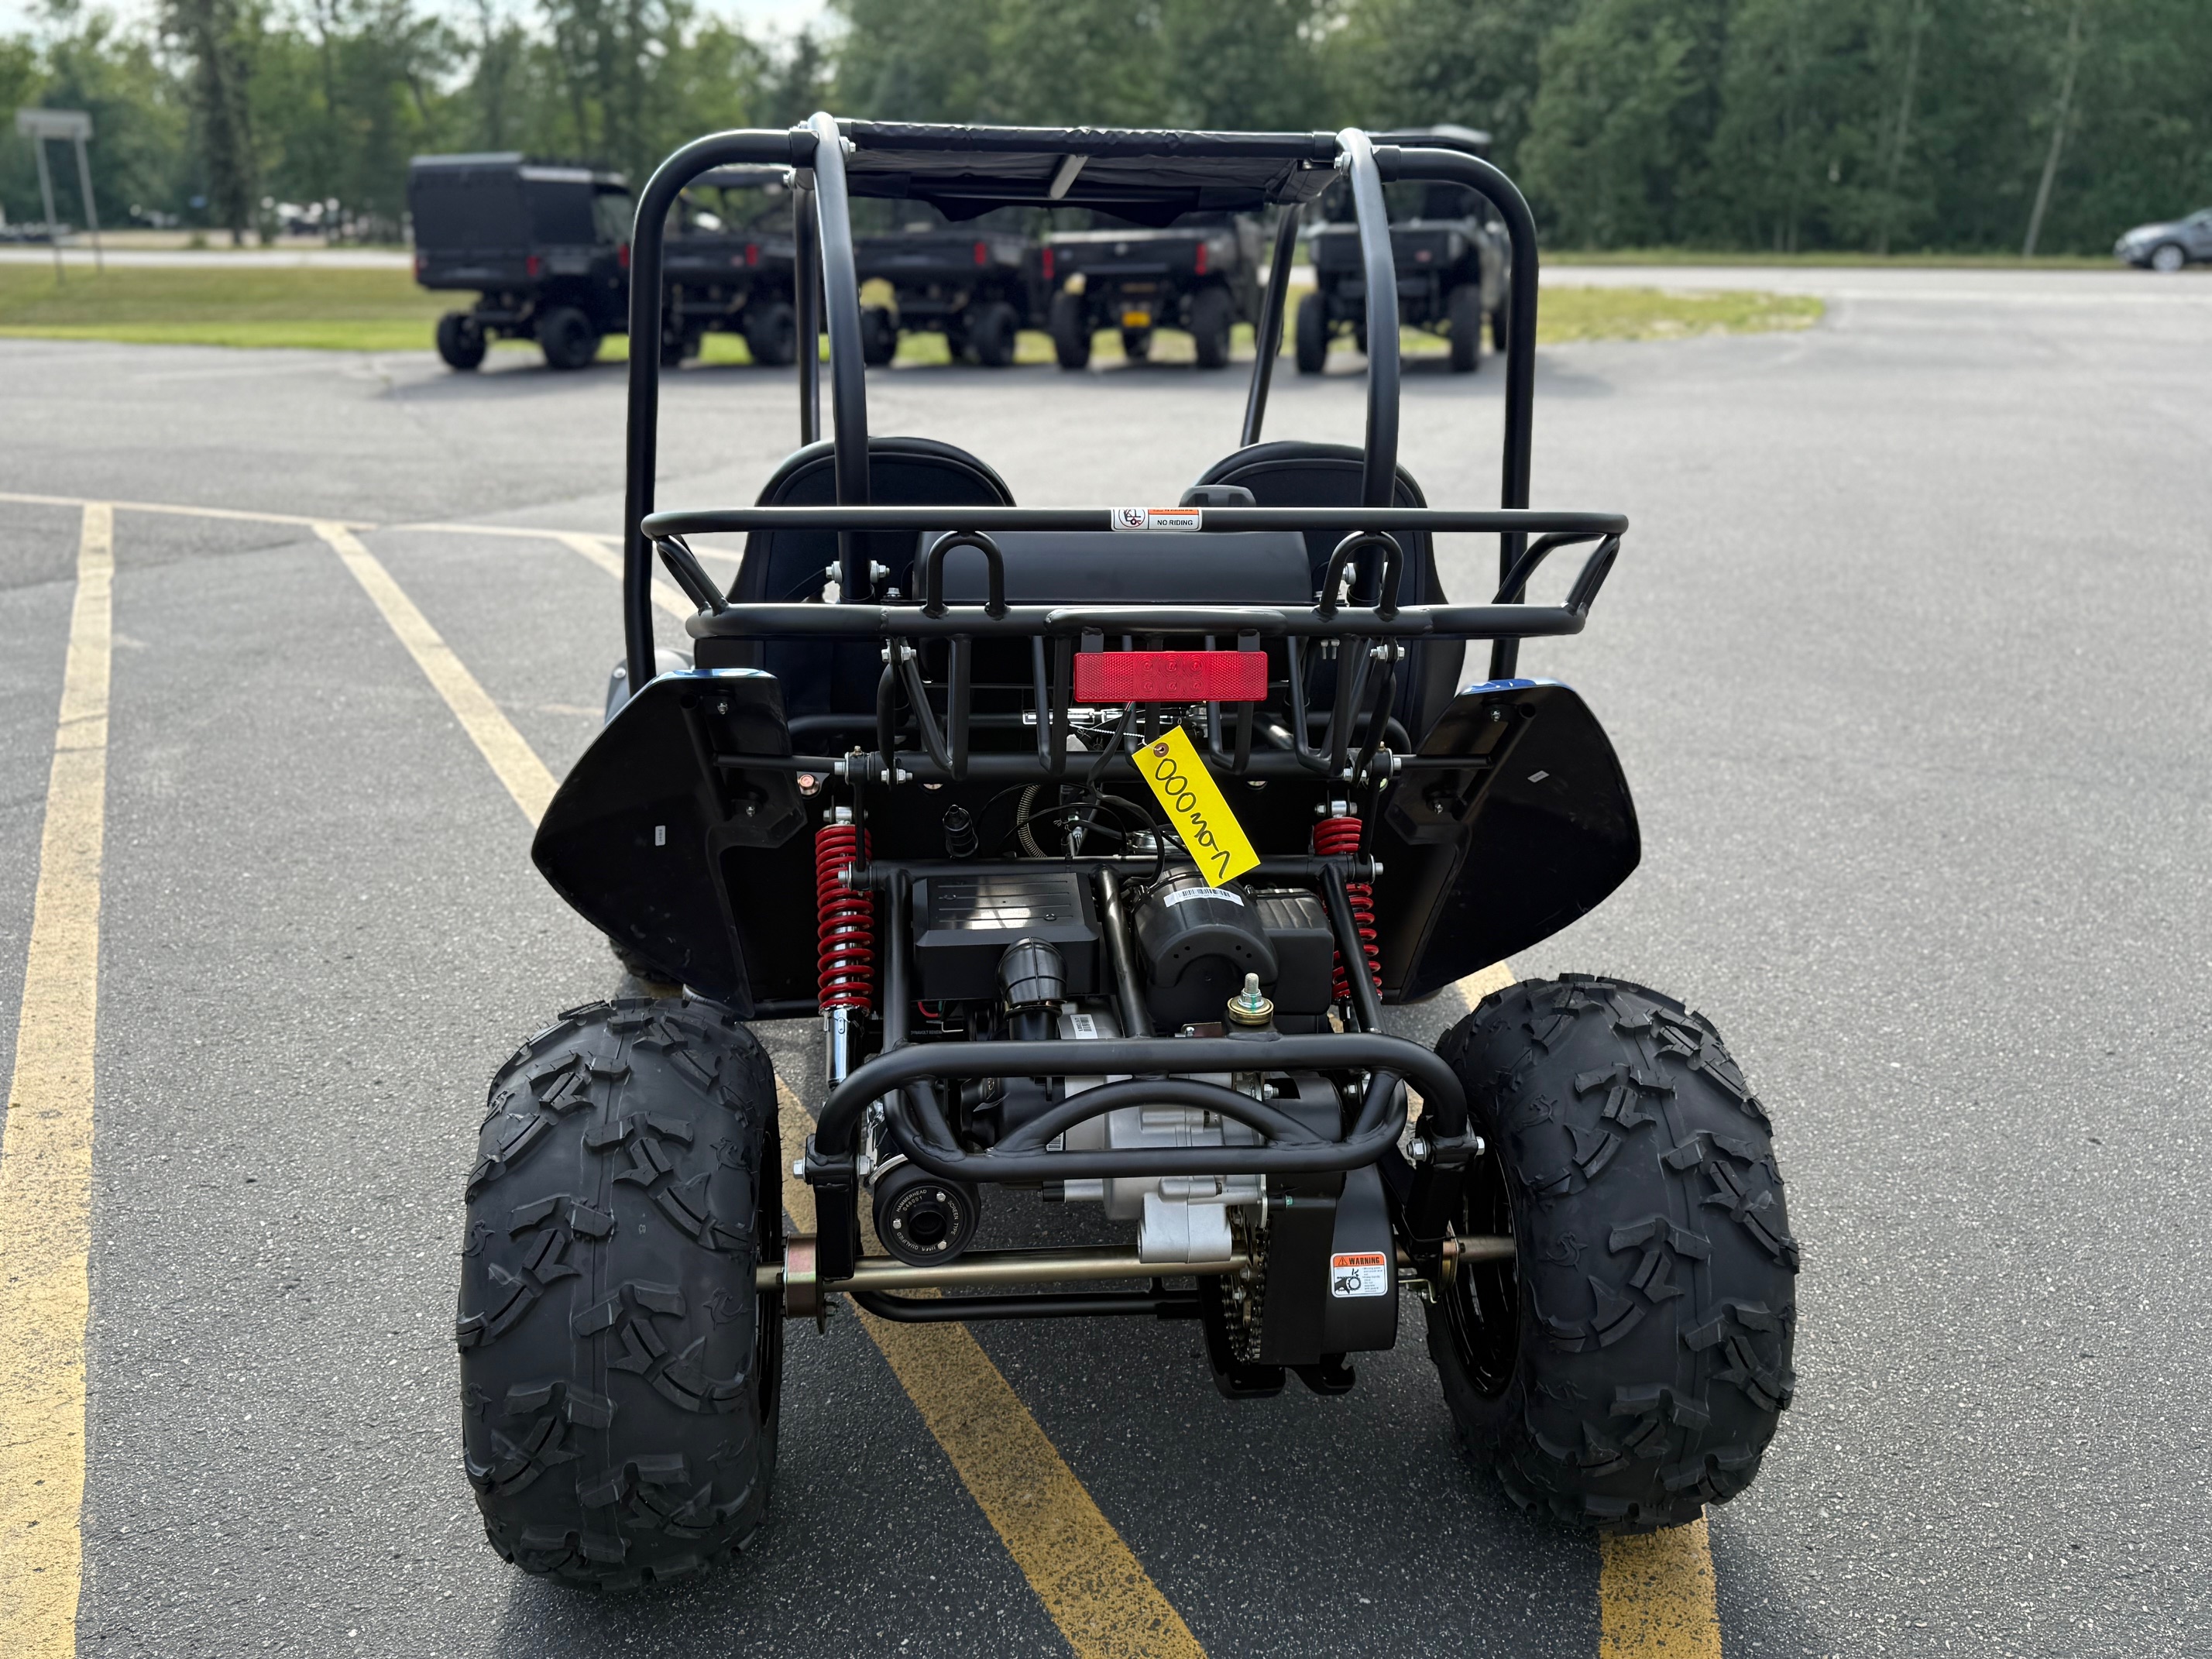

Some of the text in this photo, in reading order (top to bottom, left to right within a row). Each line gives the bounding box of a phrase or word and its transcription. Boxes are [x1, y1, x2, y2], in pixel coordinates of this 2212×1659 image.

[896, 1189, 927, 1213] HAMMERHEAD
[947, 1200, 960, 1236] SCREEN TYPE
[896, 1231, 919, 1251] QUALIFIED
[1348, 1256, 1380, 1265] WARNING
